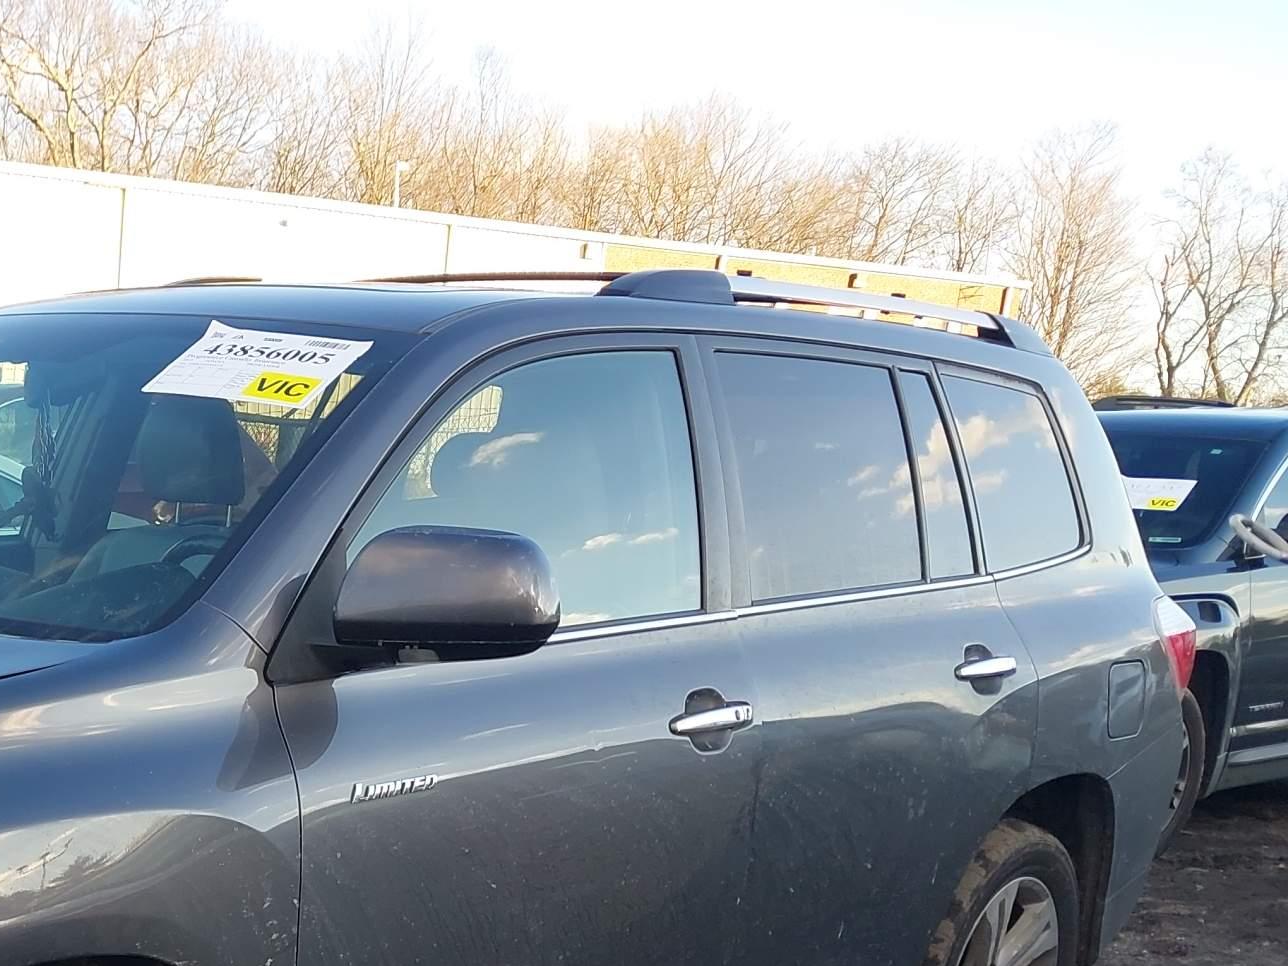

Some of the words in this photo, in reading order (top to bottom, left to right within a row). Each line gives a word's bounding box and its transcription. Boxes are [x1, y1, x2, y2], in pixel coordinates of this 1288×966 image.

[204, 343, 337, 365] 43856005
[257, 377, 311, 397] VIC
[1150, 499, 1177, 507] VIC
[351, 774, 438, 804] LIMITED
